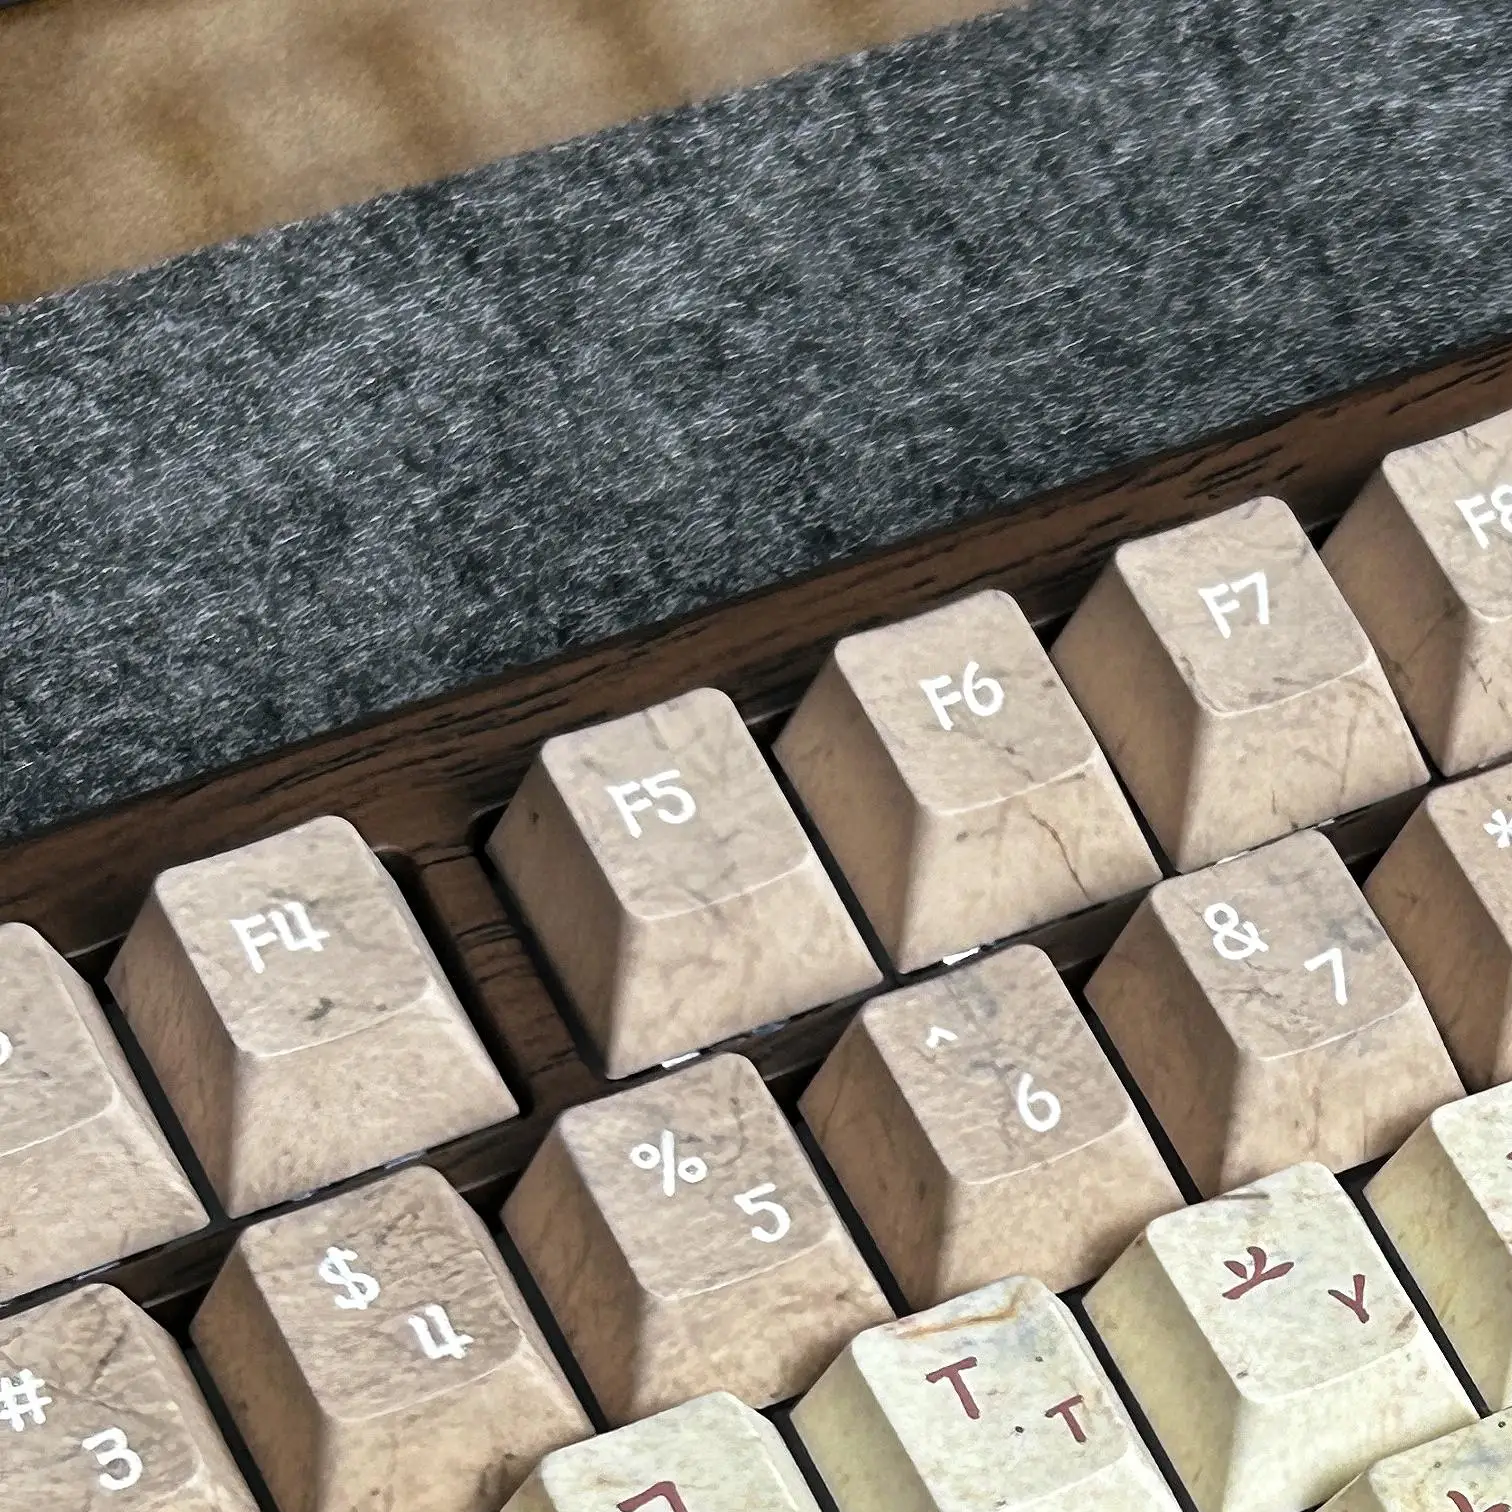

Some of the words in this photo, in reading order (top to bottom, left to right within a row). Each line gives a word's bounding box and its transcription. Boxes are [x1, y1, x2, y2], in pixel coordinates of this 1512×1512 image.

[1198, 571, 1271, 639] F7
[920, 661, 1005, 731] F6
[606, 769, 698, 839] F5
[228, 900, 331, 975] F4
[1202, 902, 1269, 961] &
[1304, 947, 1350, 1006] 7
[1014, 1072, 1061, 1132] 6
[628, 1128, 710, 1198] %
[732, 1181, 792, 1244] 5
[318, 1246, 381, 1311] $
[1221, 1246, 1294, 1299] ㅛ
[1328, 1274, 1367, 1324] Y
[406, 1302, 475, 1361] 4
[1044, 1395, 1086, 1442] T
[81, 1426, 144, 1491] 3
